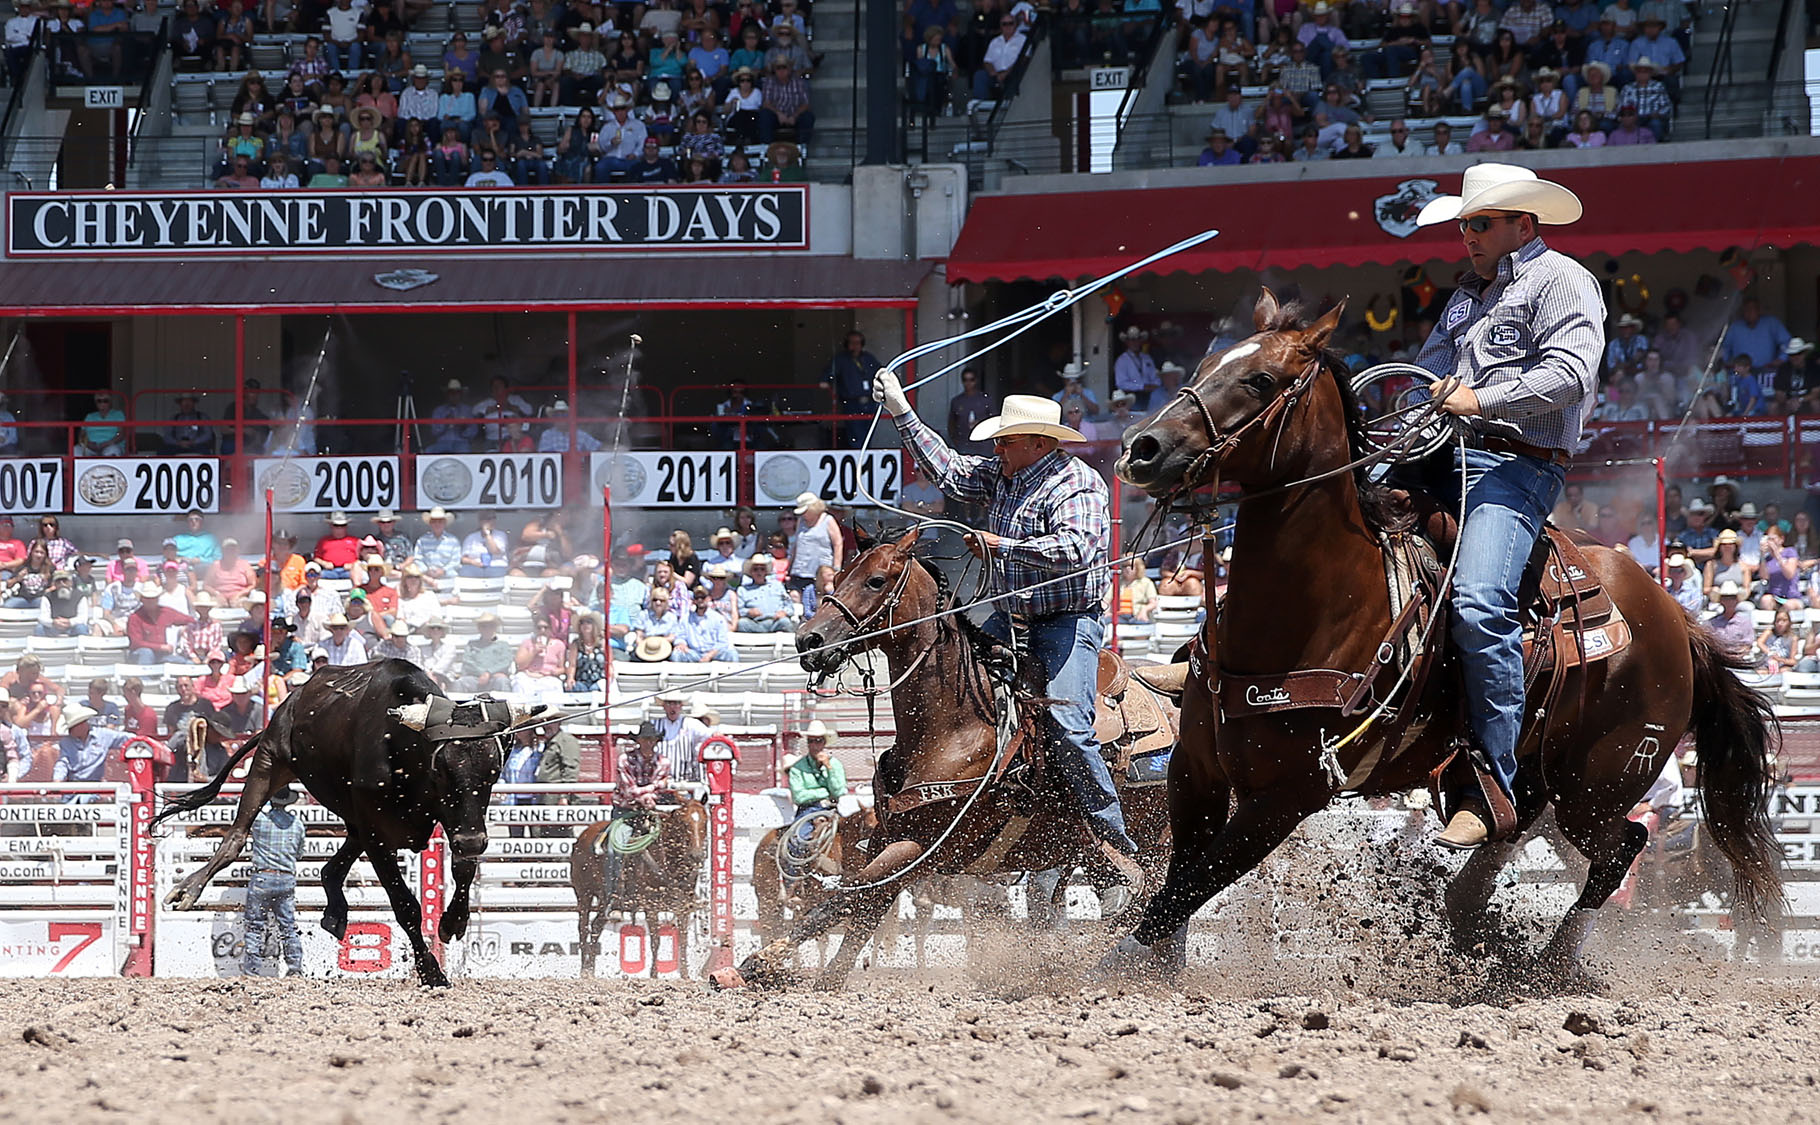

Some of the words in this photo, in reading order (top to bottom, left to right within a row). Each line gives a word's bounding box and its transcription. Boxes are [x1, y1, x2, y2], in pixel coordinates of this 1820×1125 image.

[90, 90, 118, 104] EXIT
[1096, 71, 1122, 87] EXIT
[33, 199, 328, 248] CHEYENNE
[346, 196, 623, 244] FRONTIER
[643, 193, 782, 242] DAYS
[135, 463, 213, 509] 2008
[315, 461, 394, 507] 2009
[479, 457, 558, 505] 2010
[657, 455, 732, 502] 2011
[819, 453, 898, 500] 2012
[1246, 685, 1290, 705] Coats
[63, 808, 101, 821] DAYS
[0, 867, 45, 877] o.com
[118, 807, 128, 928] CHEYENNE
[135, 806, 149, 930] CHEYENNE
[717, 808, 727, 931] CHEYENNE
[3, 945, 60, 956] NTING
[49, 922, 102, 972] 7
[338, 922, 392, 972] 8
